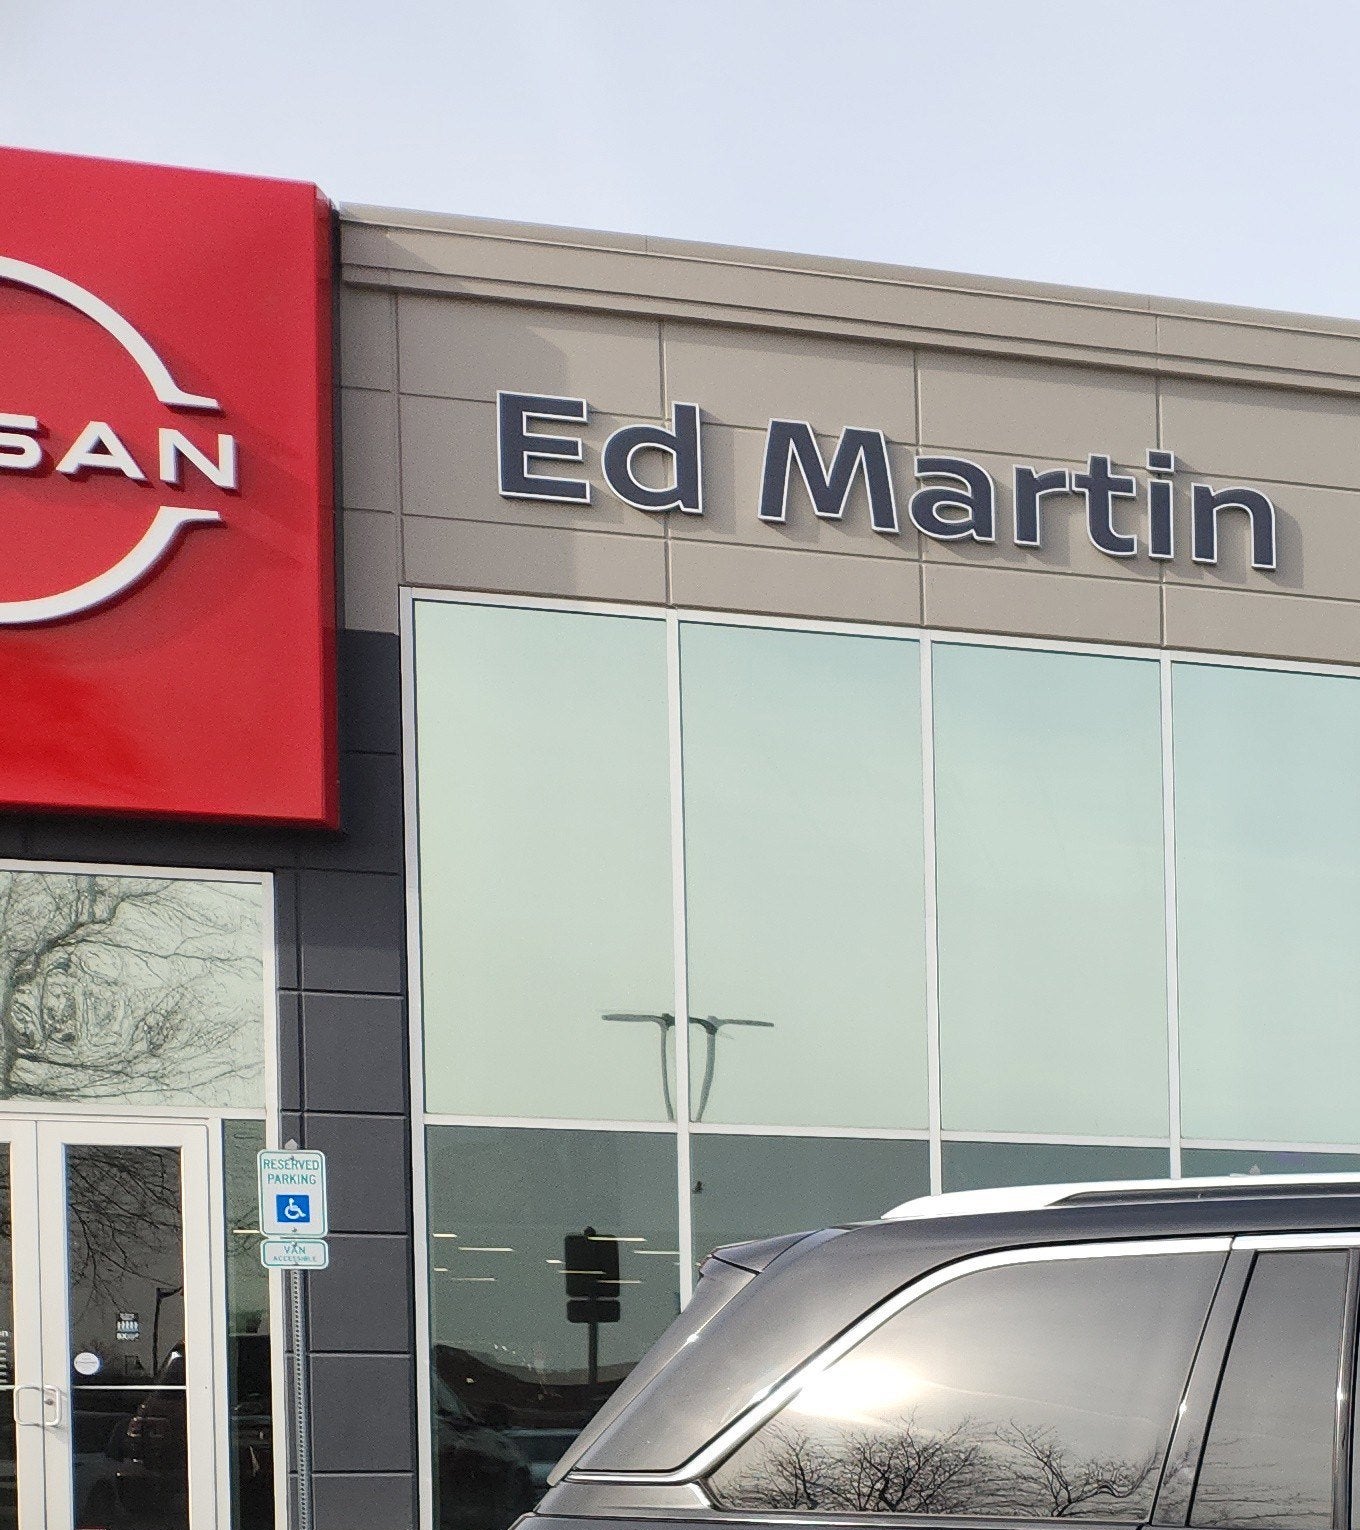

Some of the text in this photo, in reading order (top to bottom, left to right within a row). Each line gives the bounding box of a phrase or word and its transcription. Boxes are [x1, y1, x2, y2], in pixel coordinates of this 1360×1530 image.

[496, 389, 1277, 570] Ed Martin
[263, 1158, 320, 1171] RESERVED
[267, 1173, 317, 1185] PARKING
[284, 1245, 306, 1255] VAN
